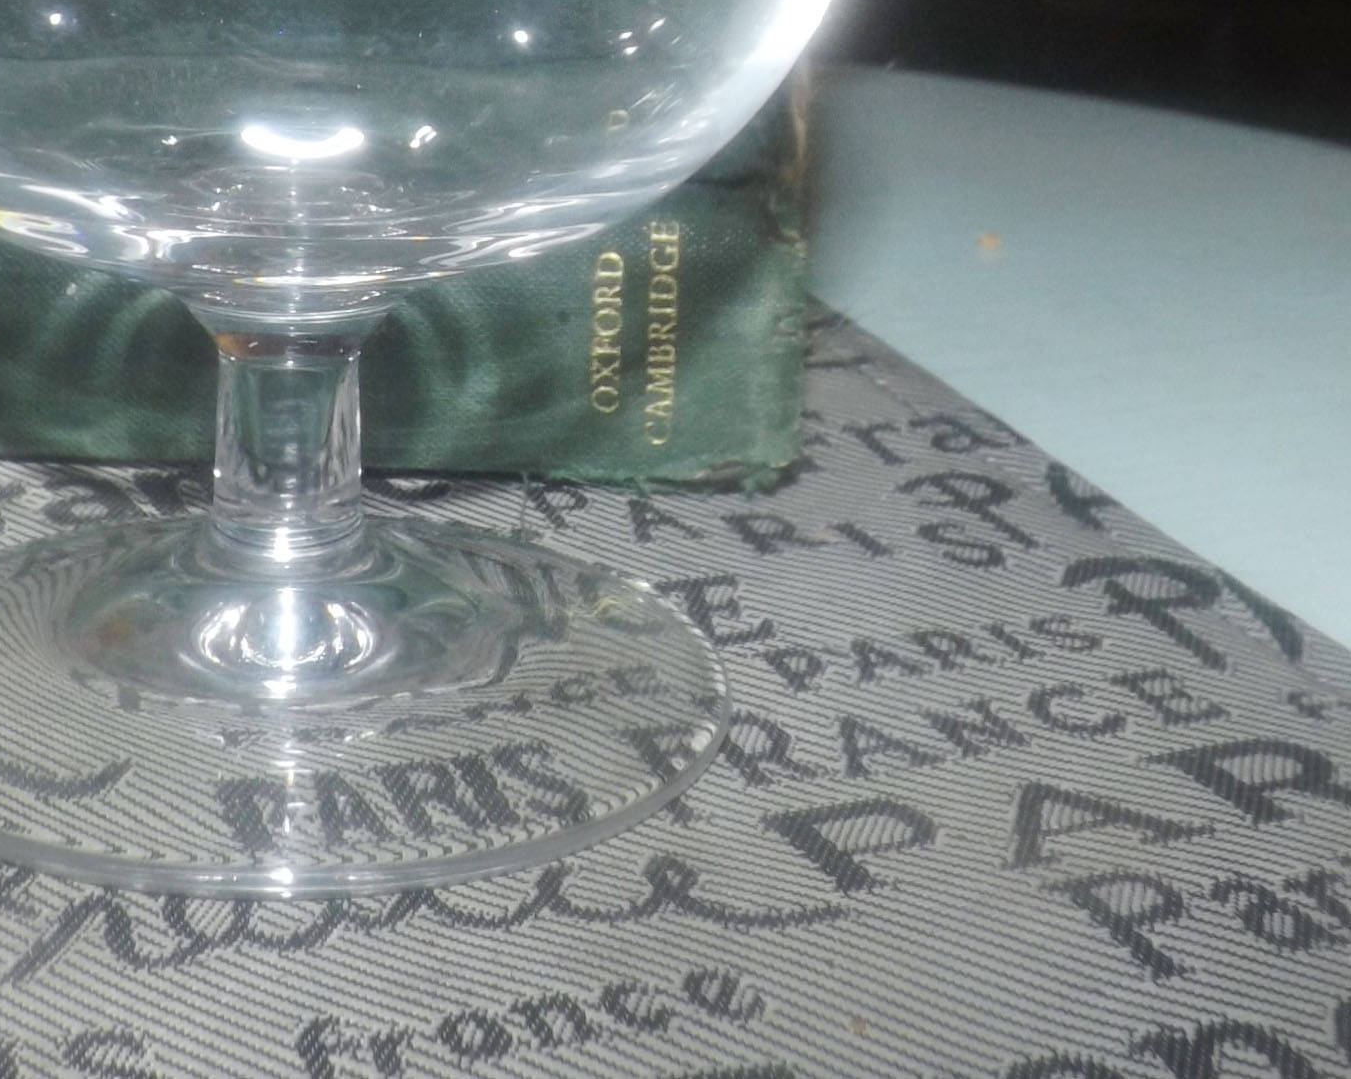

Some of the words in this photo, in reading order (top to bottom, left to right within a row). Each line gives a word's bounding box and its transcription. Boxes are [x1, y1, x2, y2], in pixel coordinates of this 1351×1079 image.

[590, 250, 625, 415] OXFORD
[643, 220, 681, 447] CAMBRIDGE
[760, 612, 1105, 694] PARIS
